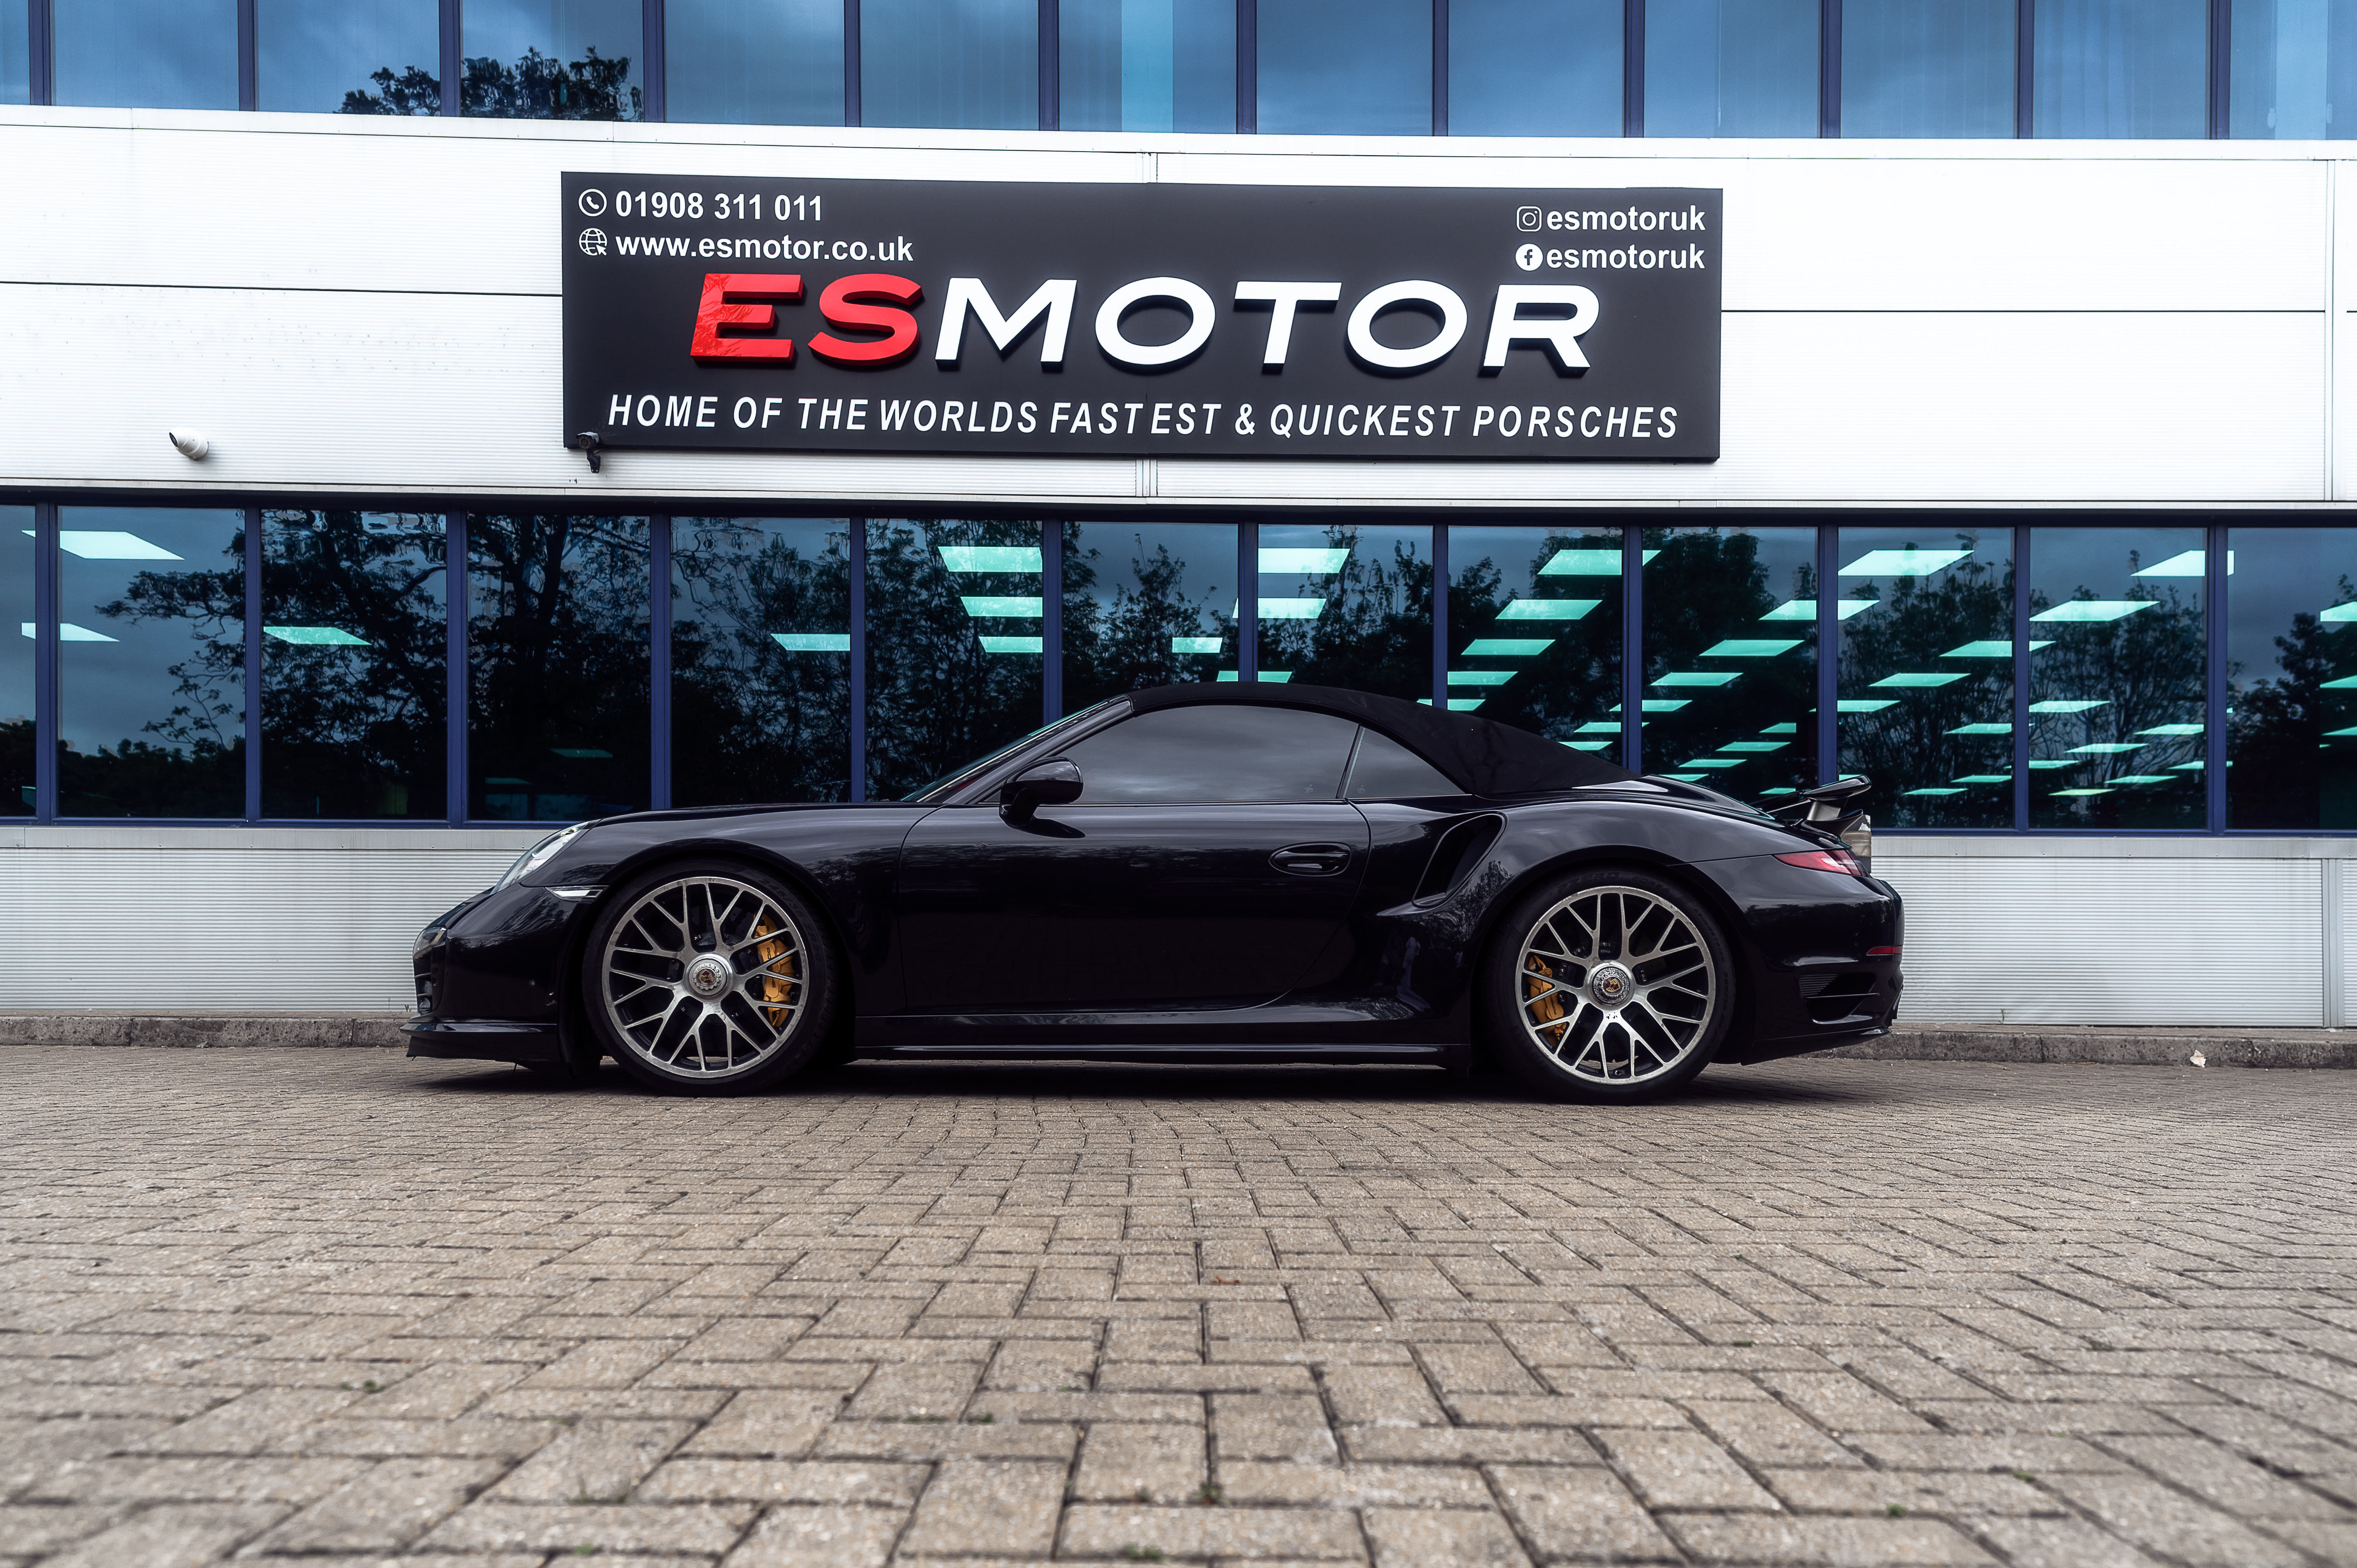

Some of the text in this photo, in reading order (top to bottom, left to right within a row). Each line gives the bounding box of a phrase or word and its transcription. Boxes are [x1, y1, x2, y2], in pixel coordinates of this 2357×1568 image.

[616, 191, 821, 221] 01908 311 011
[1547, 205, 1706, 231] esmotoruk
[615, 234, 913, 261] www.esmotor.co.uk
[1546, 243, 1705, 269] esmotoruk
[691, 274, 1599, 368] ESMOTOR
[608, 394, 1677, 438] HOME OF THE WORLDS FASTEST & QUICKEST PORSCHES
